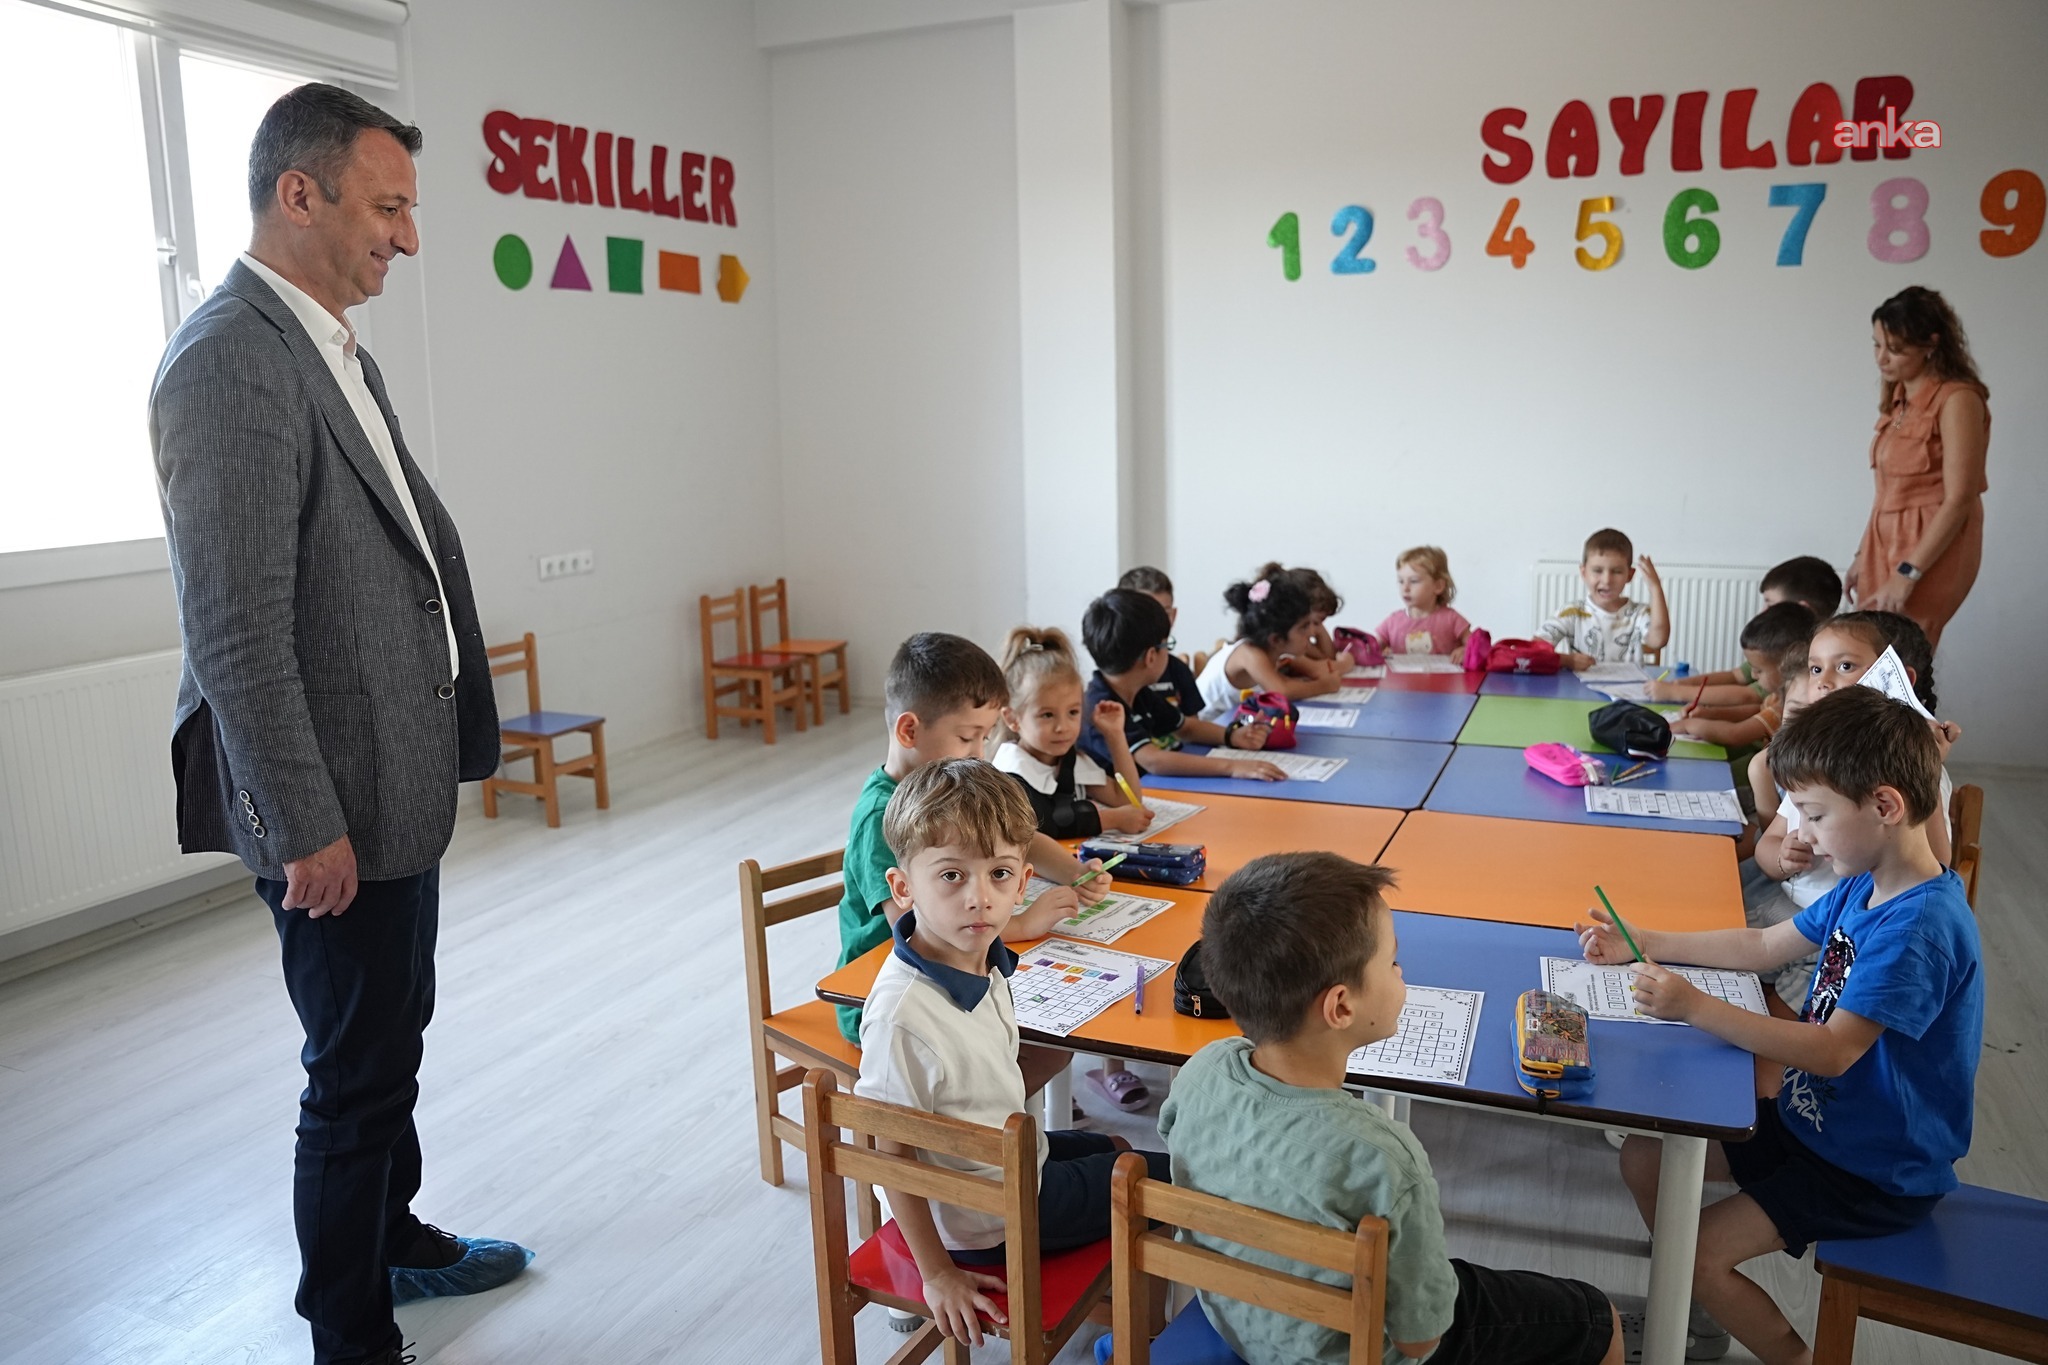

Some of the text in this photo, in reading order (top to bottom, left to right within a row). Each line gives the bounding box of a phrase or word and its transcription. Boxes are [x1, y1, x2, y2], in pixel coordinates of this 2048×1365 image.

[482, 109, 738, 228] SEKILLER
[1480, 75, 1915, 185] SAYILAR
[1266, 168, 2048, 281] 1 2 3 4 5 6 7 8 9
